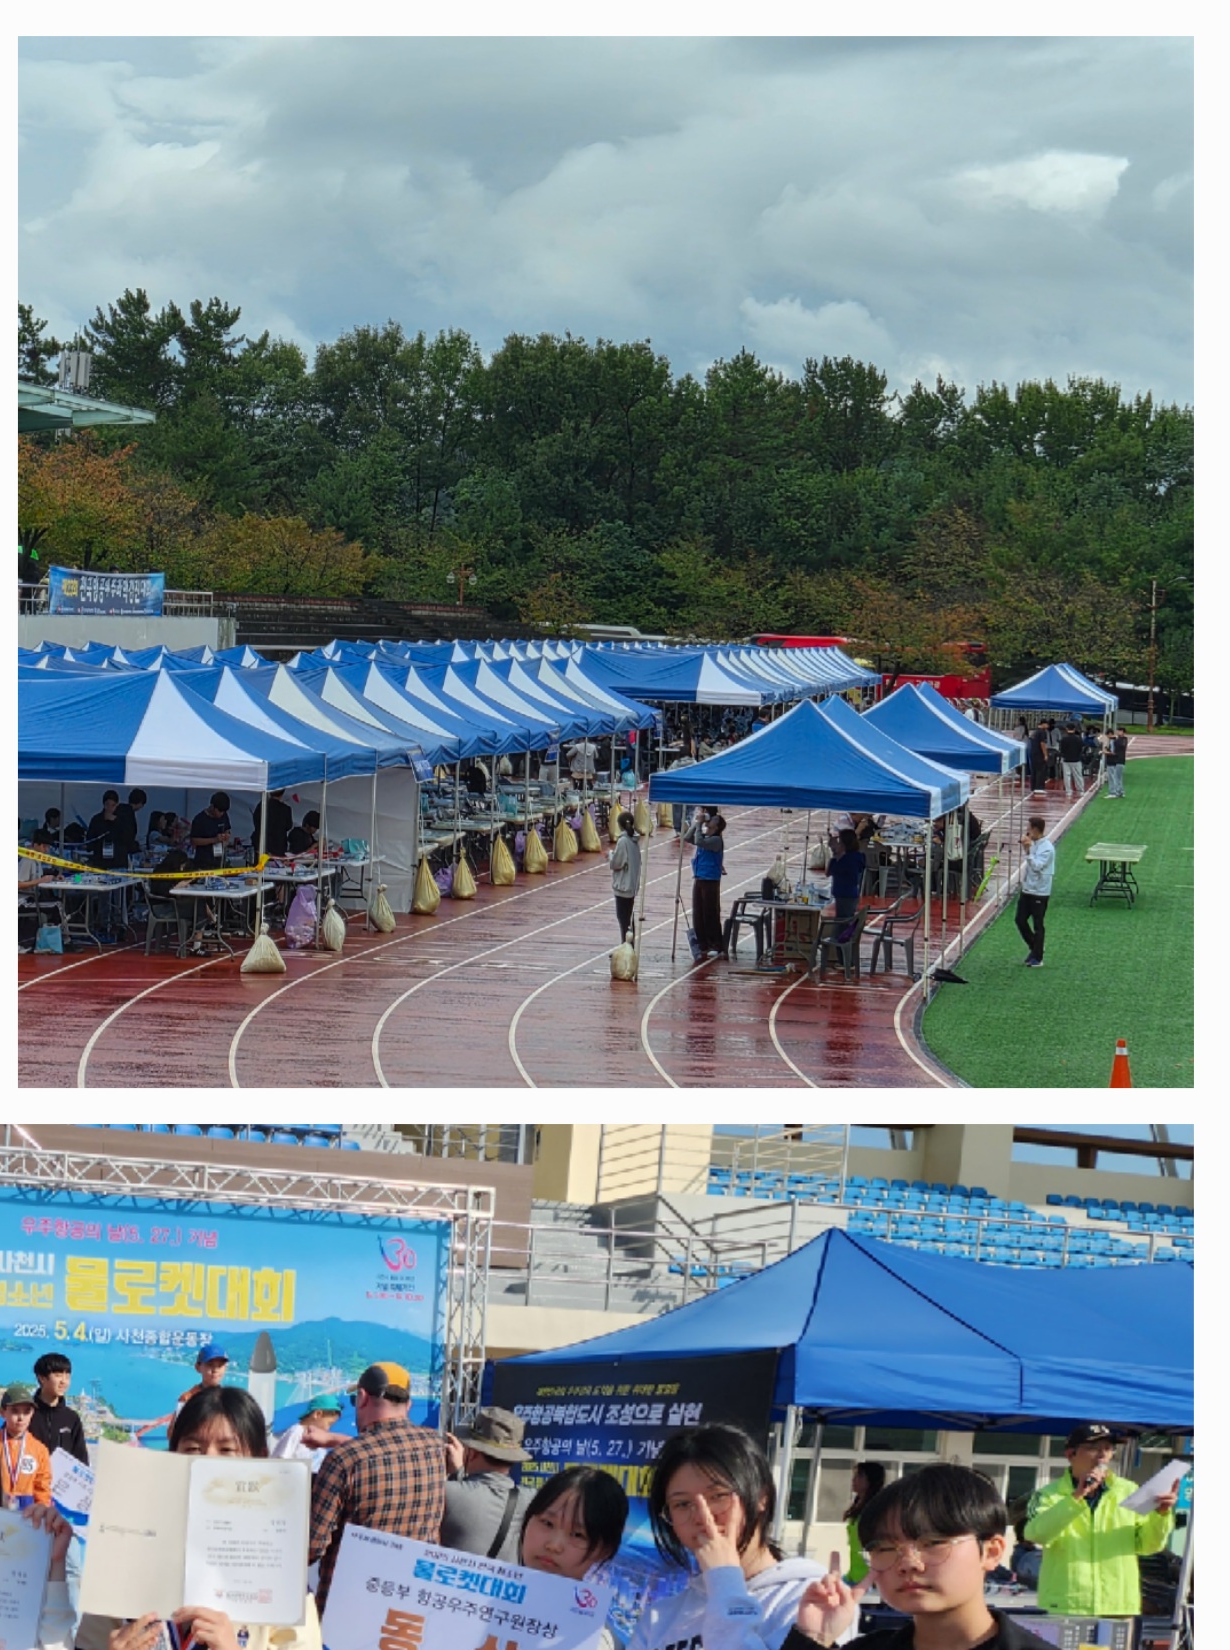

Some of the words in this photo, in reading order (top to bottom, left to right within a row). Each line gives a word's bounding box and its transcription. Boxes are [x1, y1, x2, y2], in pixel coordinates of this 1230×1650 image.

[21, 1216, 102, 1241] 우주항공의
[188, 1228, 218, 1248] 기념
[65, 1255, 297, 1323] 물로켓대회
[14, 1323, 50, 1339] 2025.
[116, 1329, 213, 1348] 사천종합운동장
[604, 1403, 665, 1426] 조성으로
[667, 1402, 704, 1426] 실현
[524, 1437, 572, 1457] 우주항공의
[413, 1558, 527, 1604] 물로켓대회
[365, 1576, 411, 1599] 중등부
[417, 1588, 558, 1639] 항공우주연구원장상
